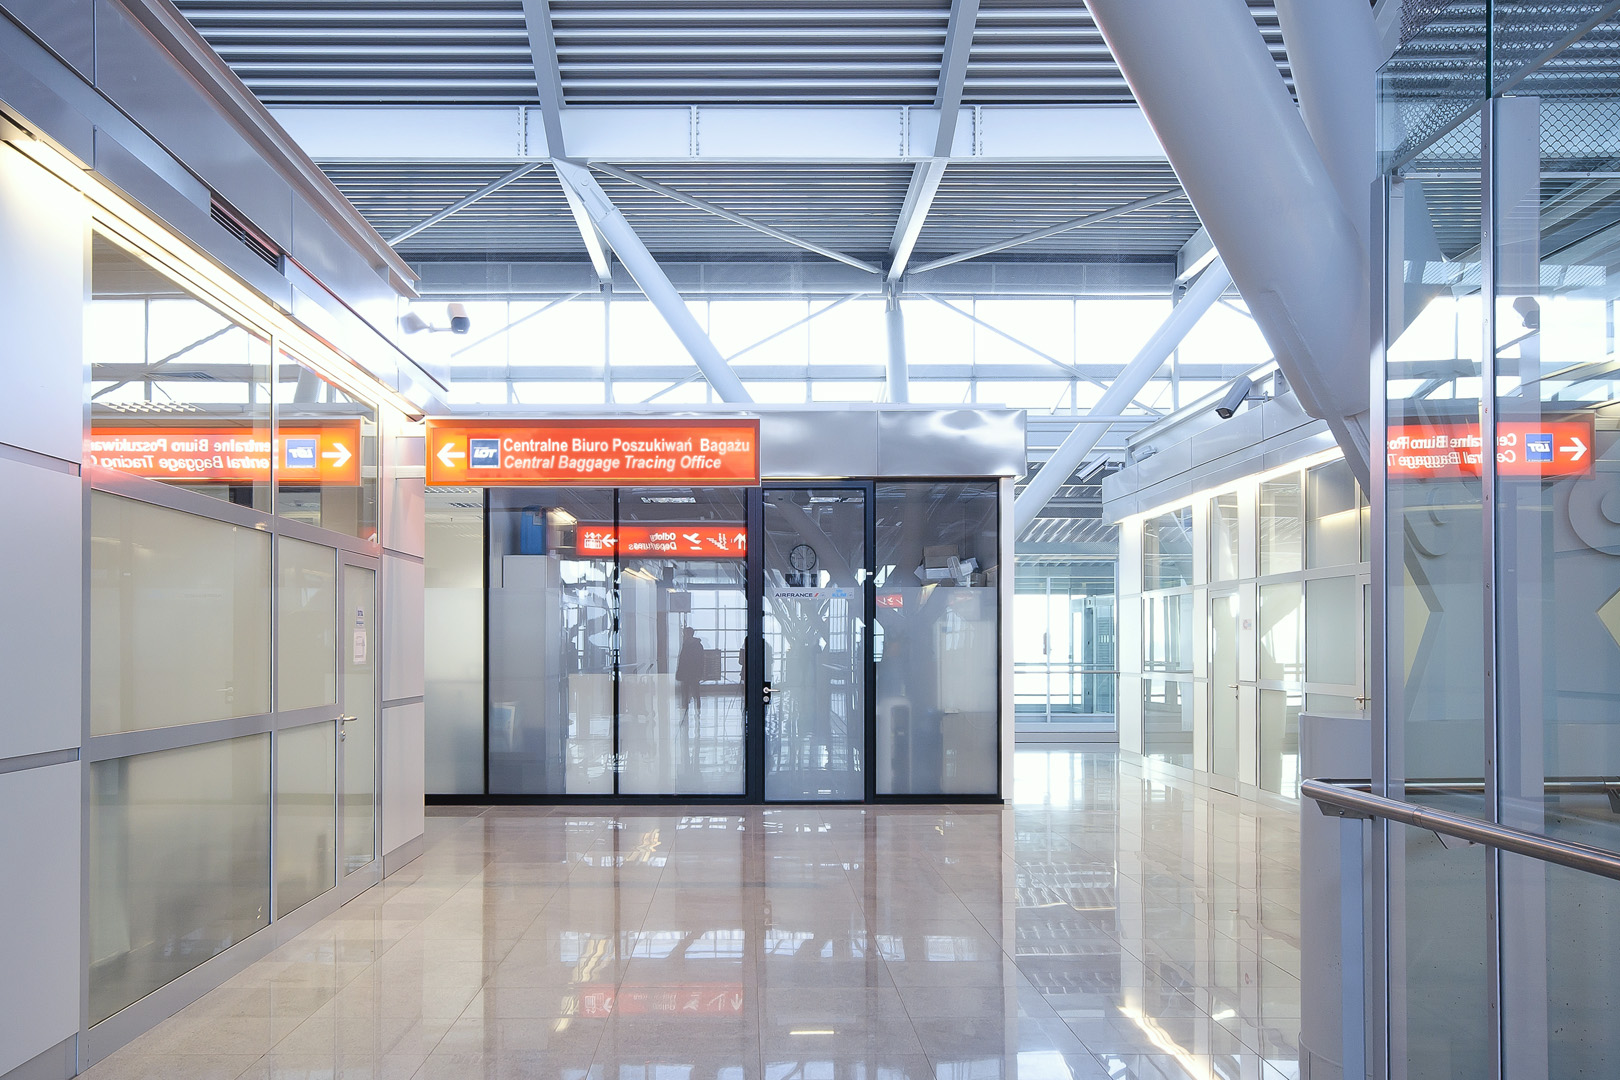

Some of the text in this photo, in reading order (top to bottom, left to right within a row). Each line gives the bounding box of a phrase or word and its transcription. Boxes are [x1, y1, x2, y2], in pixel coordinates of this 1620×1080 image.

[473, 448, 498, 459] LOT
[503, 437, 750, 455] Centralne Biuro Poszukiwań Bagażu
[504, 455, 721, 472] Central Baggage Tracing Office
